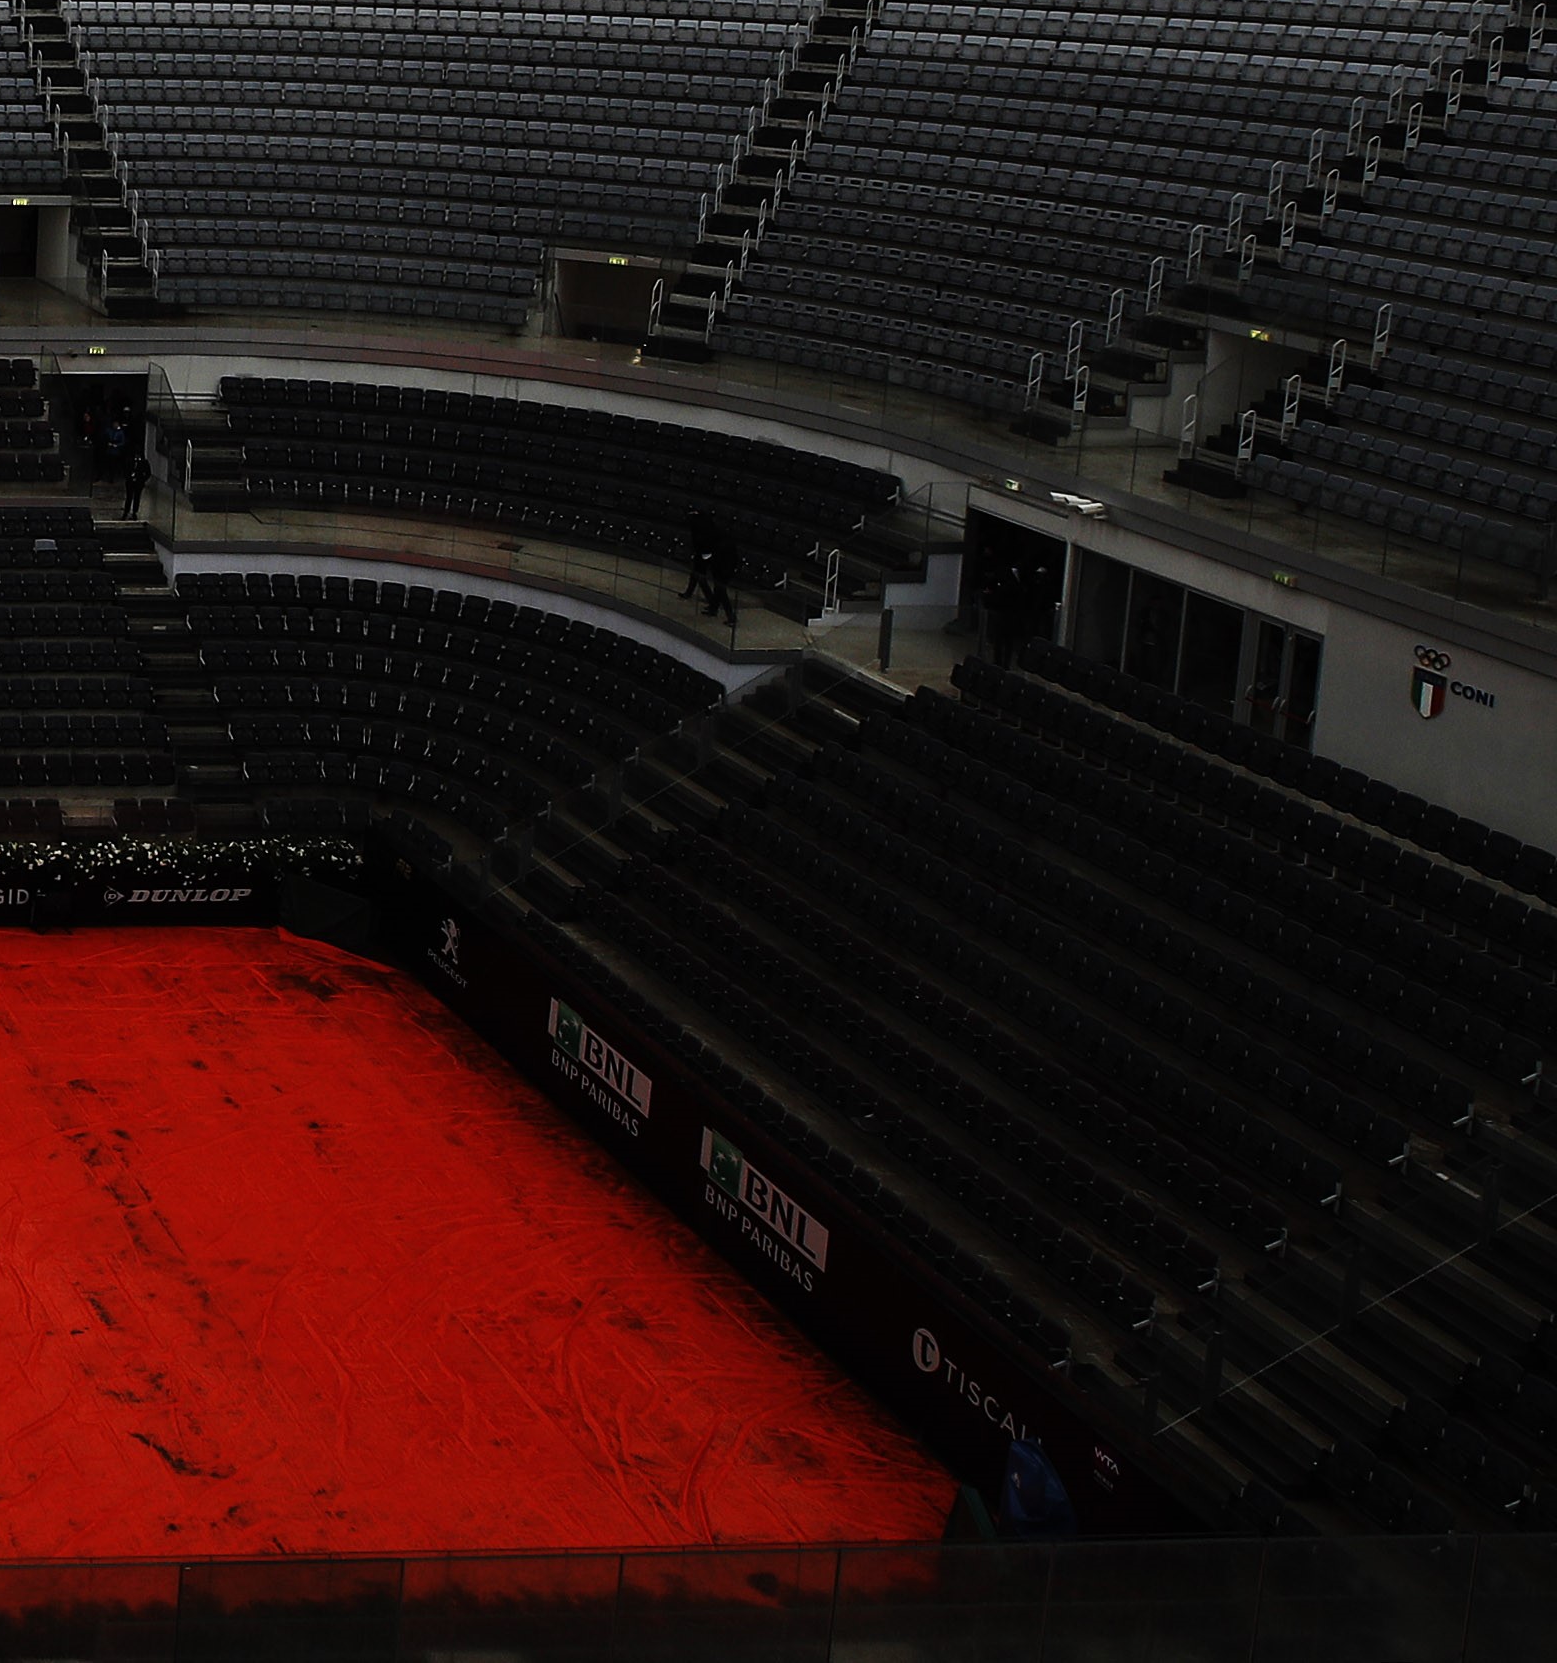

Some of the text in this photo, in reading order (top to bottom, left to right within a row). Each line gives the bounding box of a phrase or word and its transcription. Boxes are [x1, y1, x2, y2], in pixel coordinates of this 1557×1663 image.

[1451, 681, 1494, 708] CONI
[127, 888, 253, 903] DUNLOP
[551, 1048, 639, 1137] BNP PARIBAS
[585, 1030, 642, 1108] BNL
[705, 1184, 814, 1293] BNP PARIBAS
[748, 1167, 816, 1260] BNL
[944, 1356, 1041, 1446] TISCA
